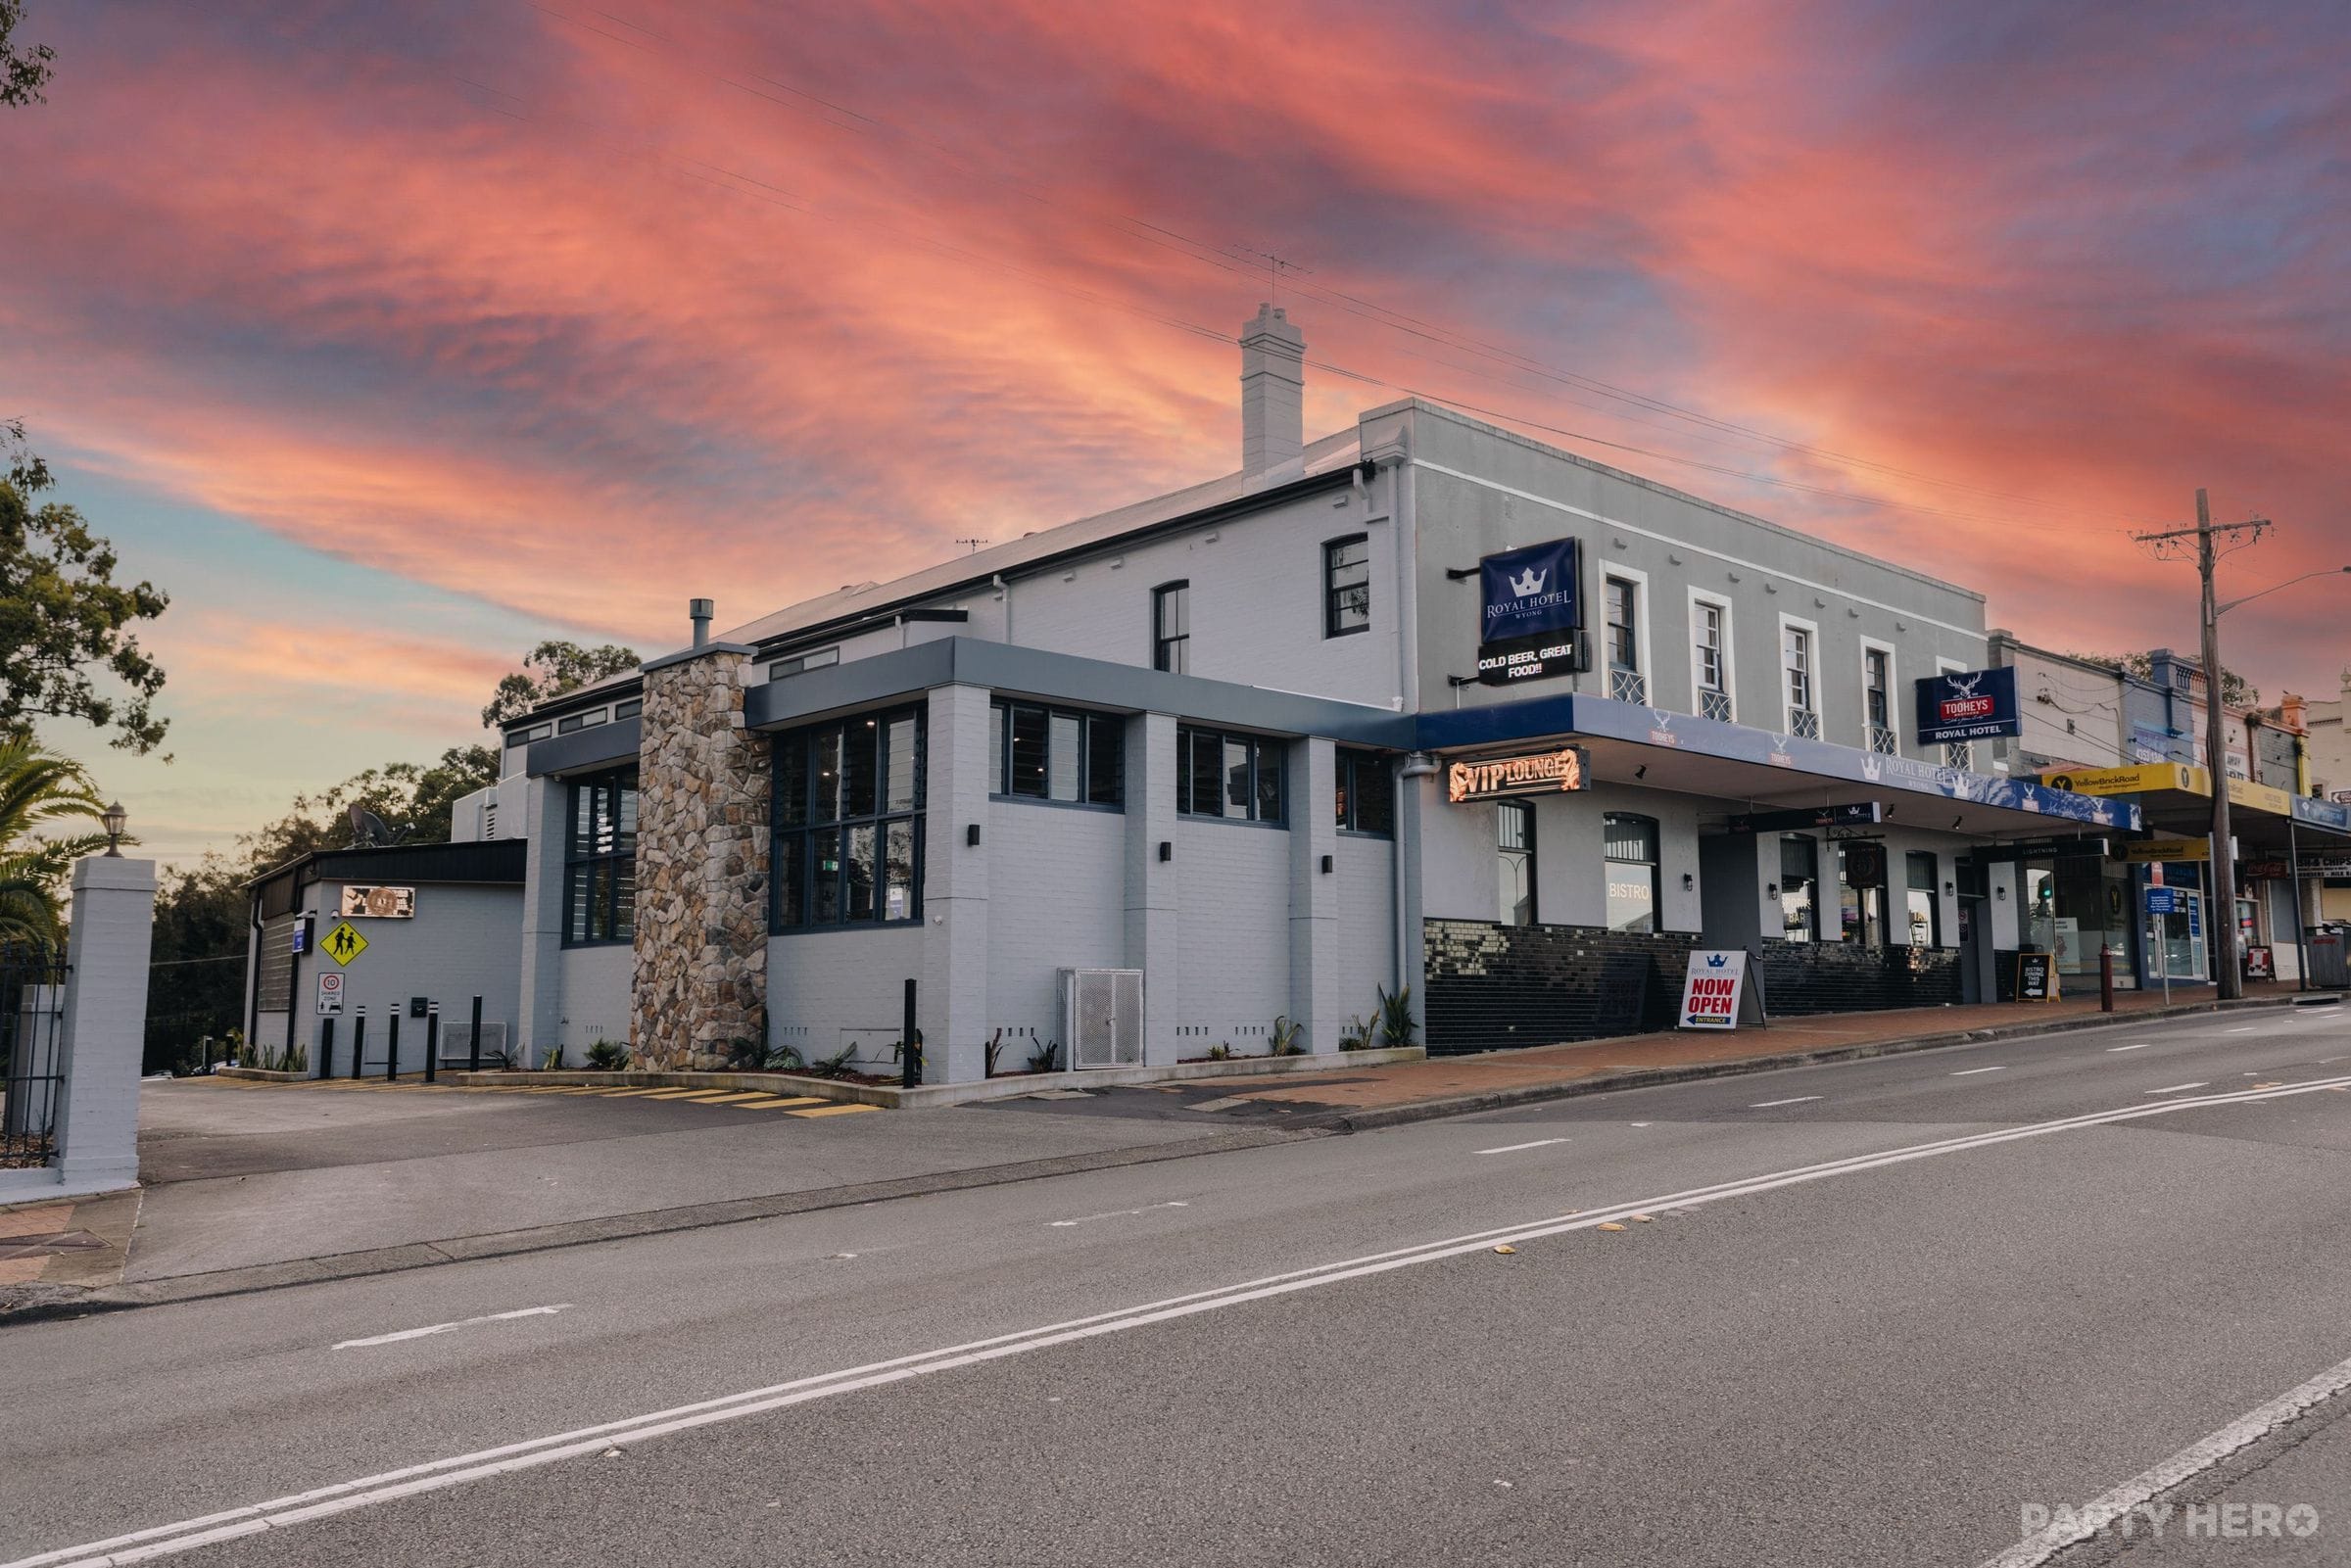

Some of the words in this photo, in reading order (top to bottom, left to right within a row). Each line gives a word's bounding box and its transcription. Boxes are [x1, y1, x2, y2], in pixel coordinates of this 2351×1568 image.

[1487, 599, 1525, 618] ROYAL
[1529, 590, 1571, 607] HOTEL
[1514, 609, 1542, 619] WYONG
[1479, 655, 1506, 670] COLD
[1508, 650, 1538, 665] BEER,
[1539, 643, 1572, 659] GREAT
[1944, 699, 1989, 714] TOOHEYS
[1935, 729, 1967, 739] ROYAL
[1969, 725, 2001, 736] HOTEL
[1467, 764, 1504, 792] VIP
[1505, 756, 1564, 782] LOUNGE
[1886, 757, 1916, 777] ROYAL
[1917, 765, 1945, 784] HOTEL
[2075, 773, 2139, 786] YellowBrickRoad
[1608, 882, 1650, 900] BISTRO
[1789, 912, 1806, 924] BAR
[1691, 967, 1713, 975] ROYAL
[1716, 967, 1740, 975] HOTEL
[1692, 978, 1735, 996] NOW
[1688, 996, 1733, 1014] OPEN
